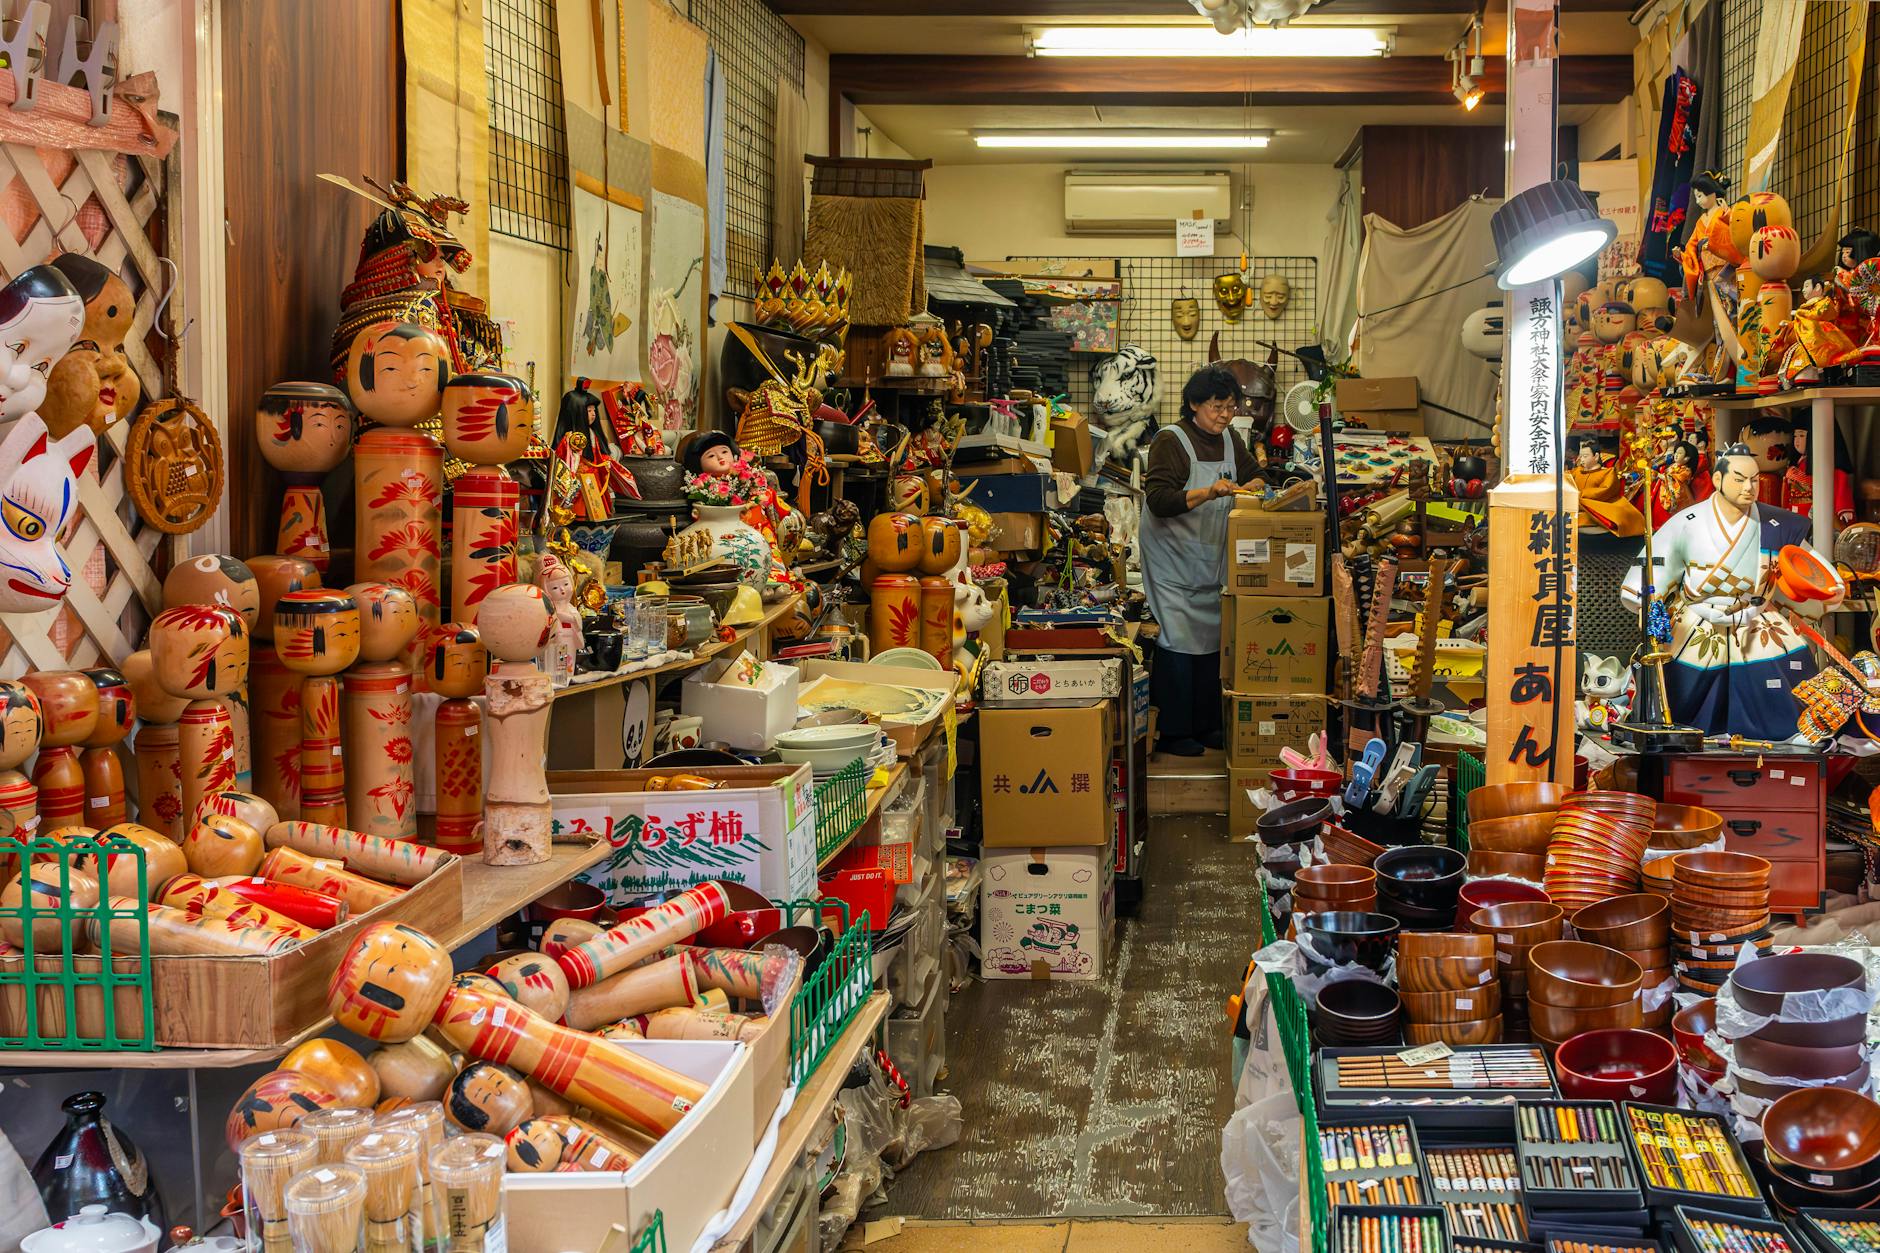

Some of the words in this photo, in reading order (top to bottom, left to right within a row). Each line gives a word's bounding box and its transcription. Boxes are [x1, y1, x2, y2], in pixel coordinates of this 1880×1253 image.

[1528, 511, 1575, 648] 雑貨屋
[1246, 641, 1259, 655] 共
[1054, 679, 1096, 687] とちあいか
[1508, 662, 1553, 768] あん
[993, 774, 1011, 794] 共
[1071, 773, 1090, 793] 撰
[850, 873, 866, 881] JUST
[1015, 903, 1061, 915] こまつ菜
